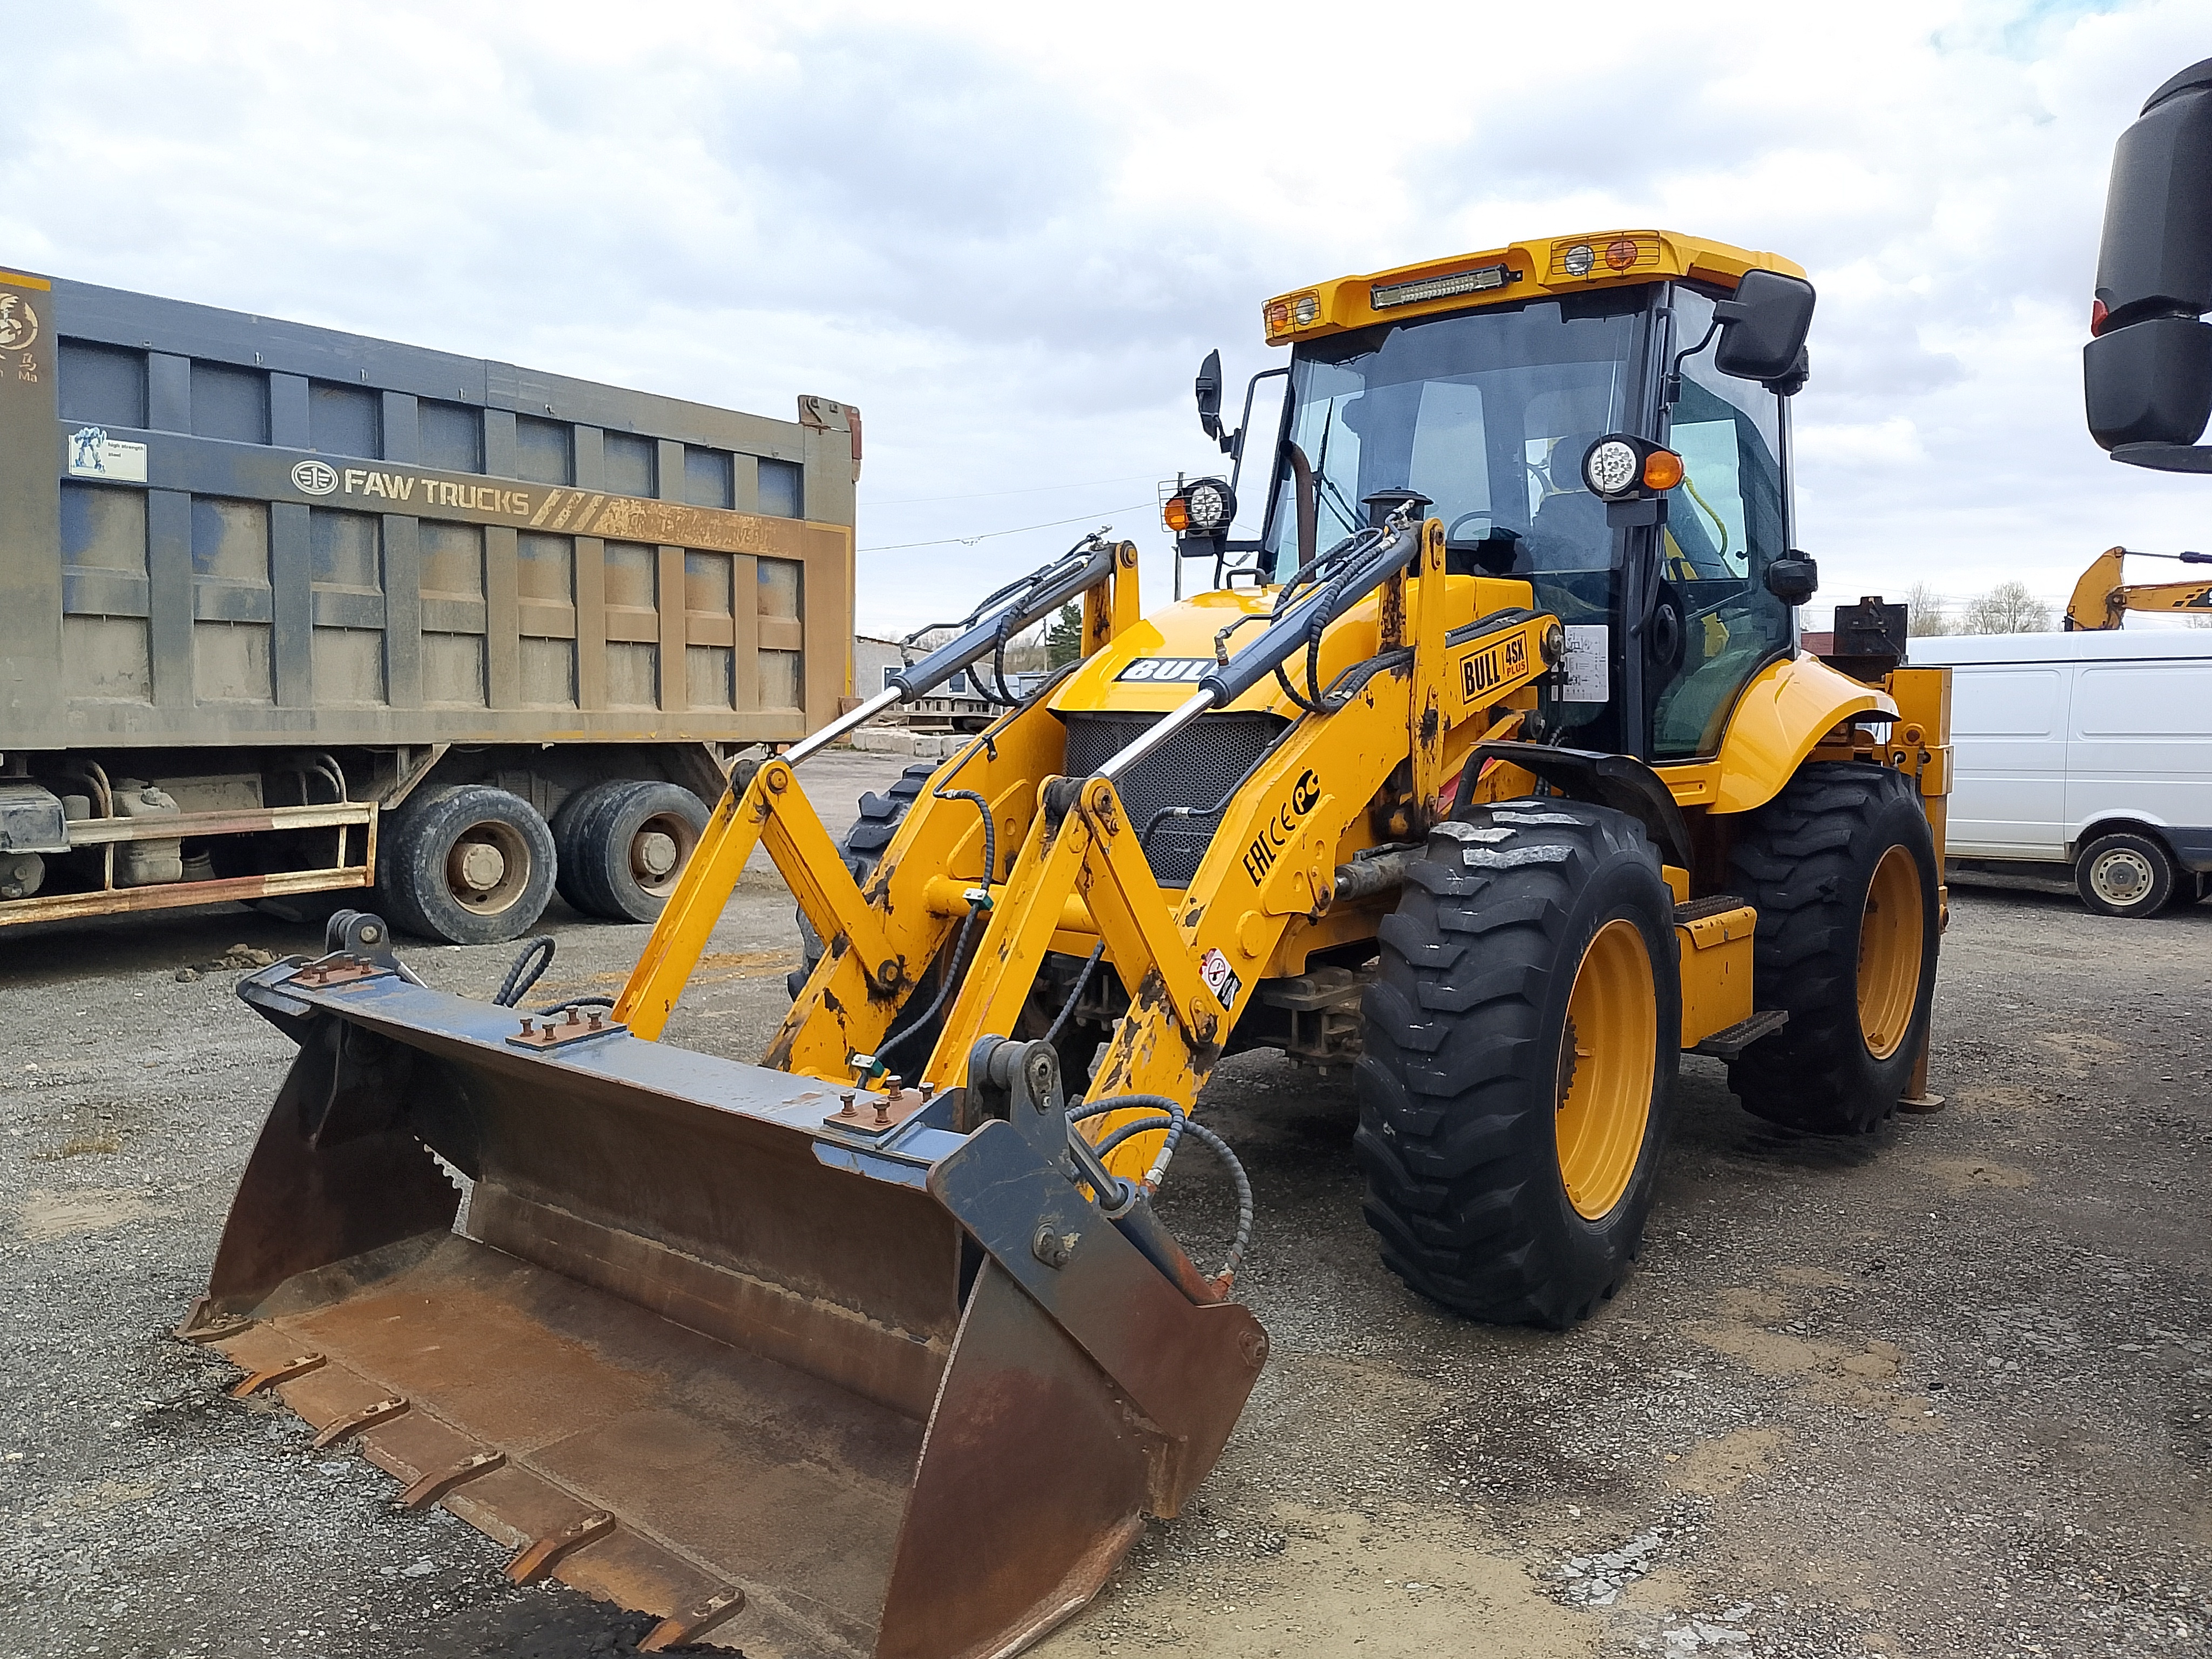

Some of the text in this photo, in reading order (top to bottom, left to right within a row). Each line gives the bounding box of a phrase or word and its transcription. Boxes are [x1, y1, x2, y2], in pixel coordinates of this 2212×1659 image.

[18, 370, 37, 383] Ma
[345, 468, 530, 516] FAW TRUCKS
[1464, 650, 1501, 697] BULL
[1506, 638, 1525, 666] 4SX
[1506, 661, 1526, 677] PLUS
